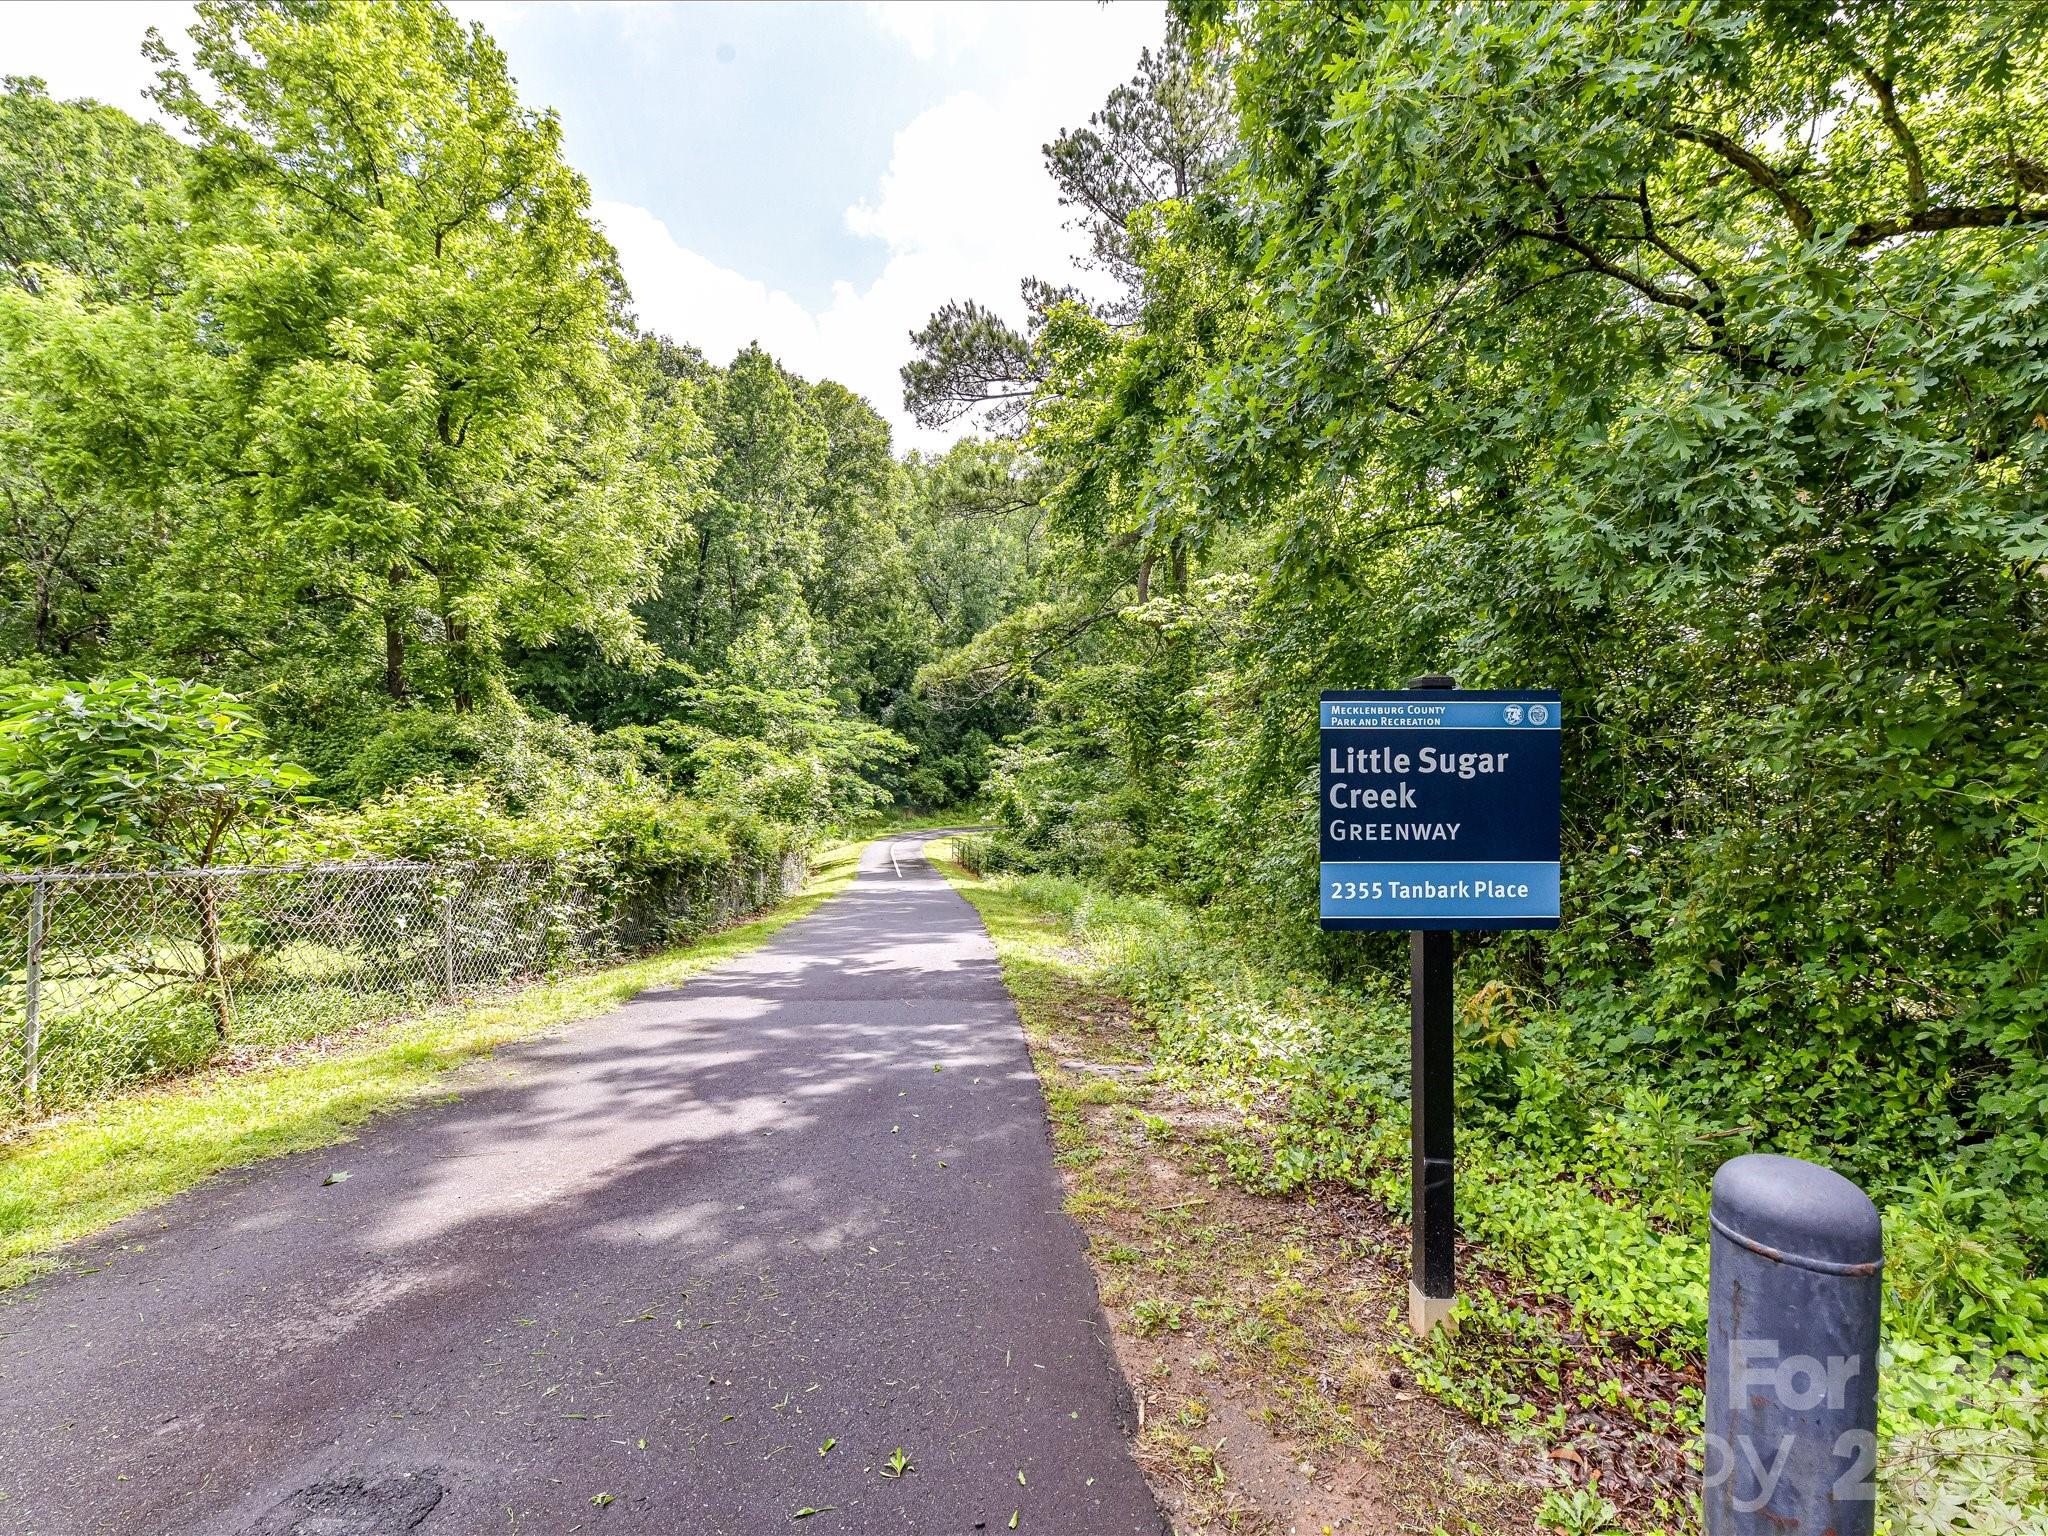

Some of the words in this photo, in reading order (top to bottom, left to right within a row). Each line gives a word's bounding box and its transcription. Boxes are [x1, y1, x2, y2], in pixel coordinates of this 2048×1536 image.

[1331, 705, 1404, 715] MECKLENBURG
[1407, 705, 1446, 715] COUNTY
[1331, 717, 1357, 726] PARK
[1358, 718, 1378, 726] AND
[1381, 717, 1441, 726] RECREATION
[1330, 746, 1411, 774] Little
[1418, 747, 1509, 780] Sugar
[1329, 781, 1417, 809] Creek
[1329, 819, 1461, 841] GREENWAY
[1331, 881, 1383, 900] 2355
[1388, 880, 1470, 899] Tanbark
[1474, 880, 1529, 898] Place
